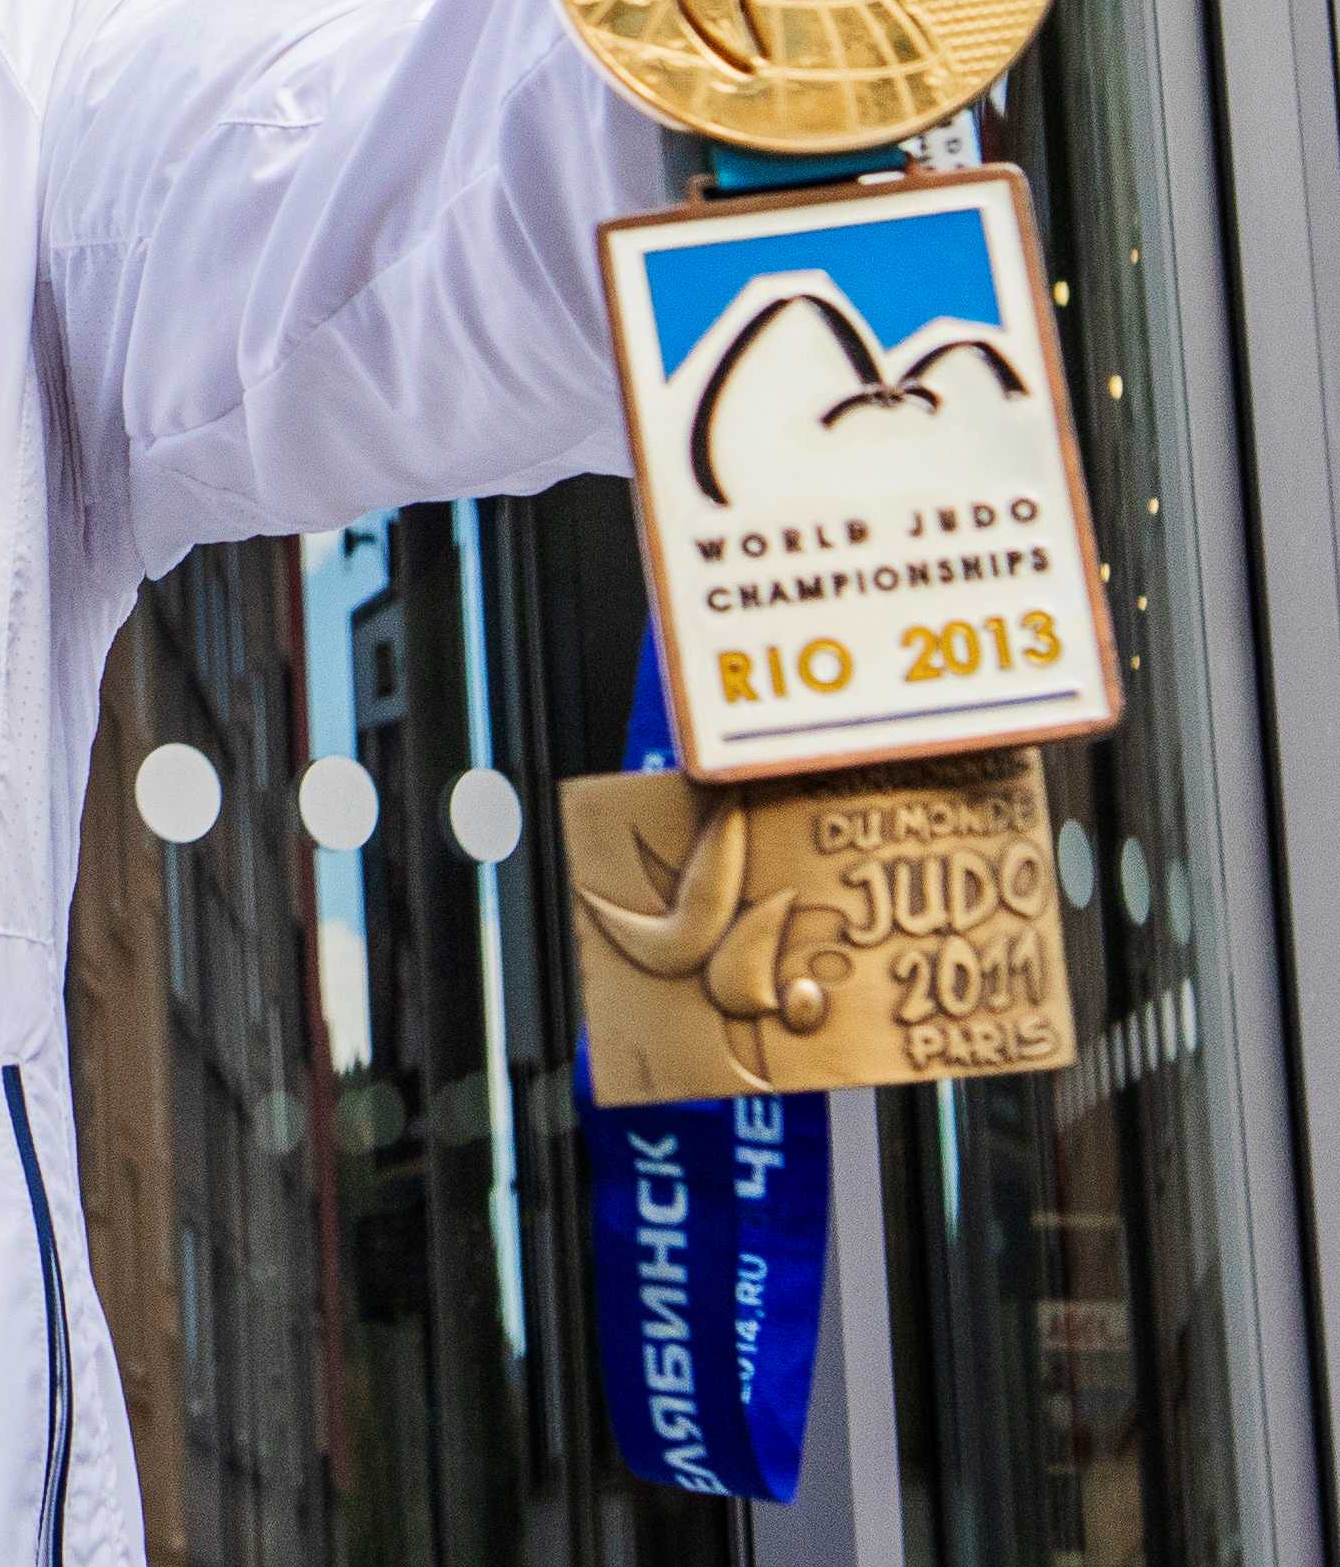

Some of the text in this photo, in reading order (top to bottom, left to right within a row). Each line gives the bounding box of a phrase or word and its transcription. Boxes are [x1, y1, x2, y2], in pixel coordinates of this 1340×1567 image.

[694, 495, 1040, 563] WORLD JUDO
[706, 546, 1051, 614] CHAMPIONSHIPS
[717, 609, 1064, 705] RIO 2013
[840, 838, 1049, 948] JUDO
[889, 929, 1049, 1026] 2011
[904, 1014, 1063, 1070] PARIS
